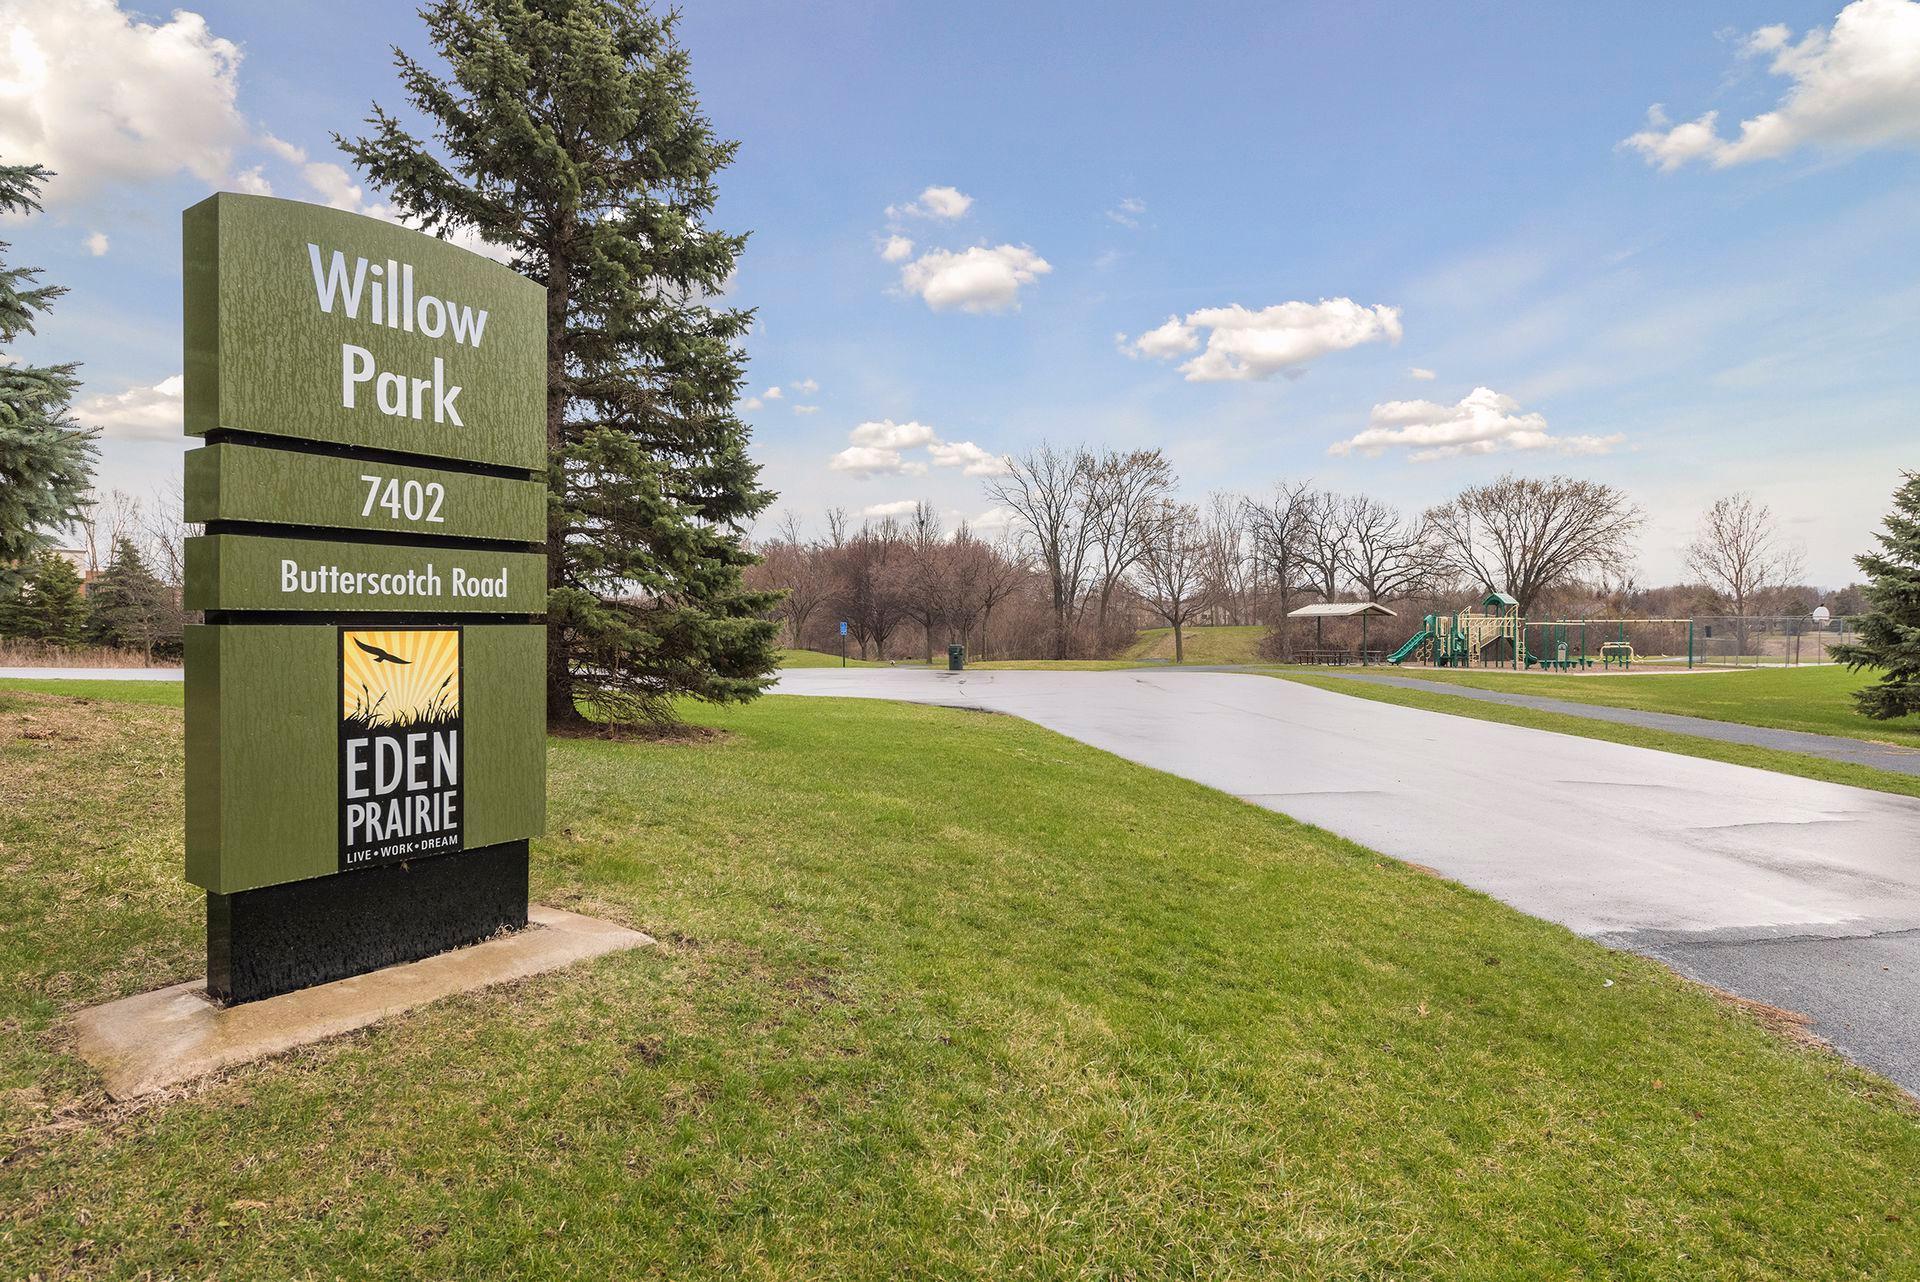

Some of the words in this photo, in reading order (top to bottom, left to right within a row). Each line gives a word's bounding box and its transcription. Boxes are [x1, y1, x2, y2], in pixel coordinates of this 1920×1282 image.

[307, 242, 488, 347] Willow
[342, 343, 464, 427] Park
[361, 475, 445, 523] 7402
[281, 559, 442, 596] Butterscotch
[452, 567, 508, 598] Road
[346, 730, 457, 799] EDEN
[347, 791, 457, 846] PRAIRIE
[347, 849, 371, 864] LIVE
[380, 842, 413, 857] WORK
[421, 834, 458, 850] DREAM
